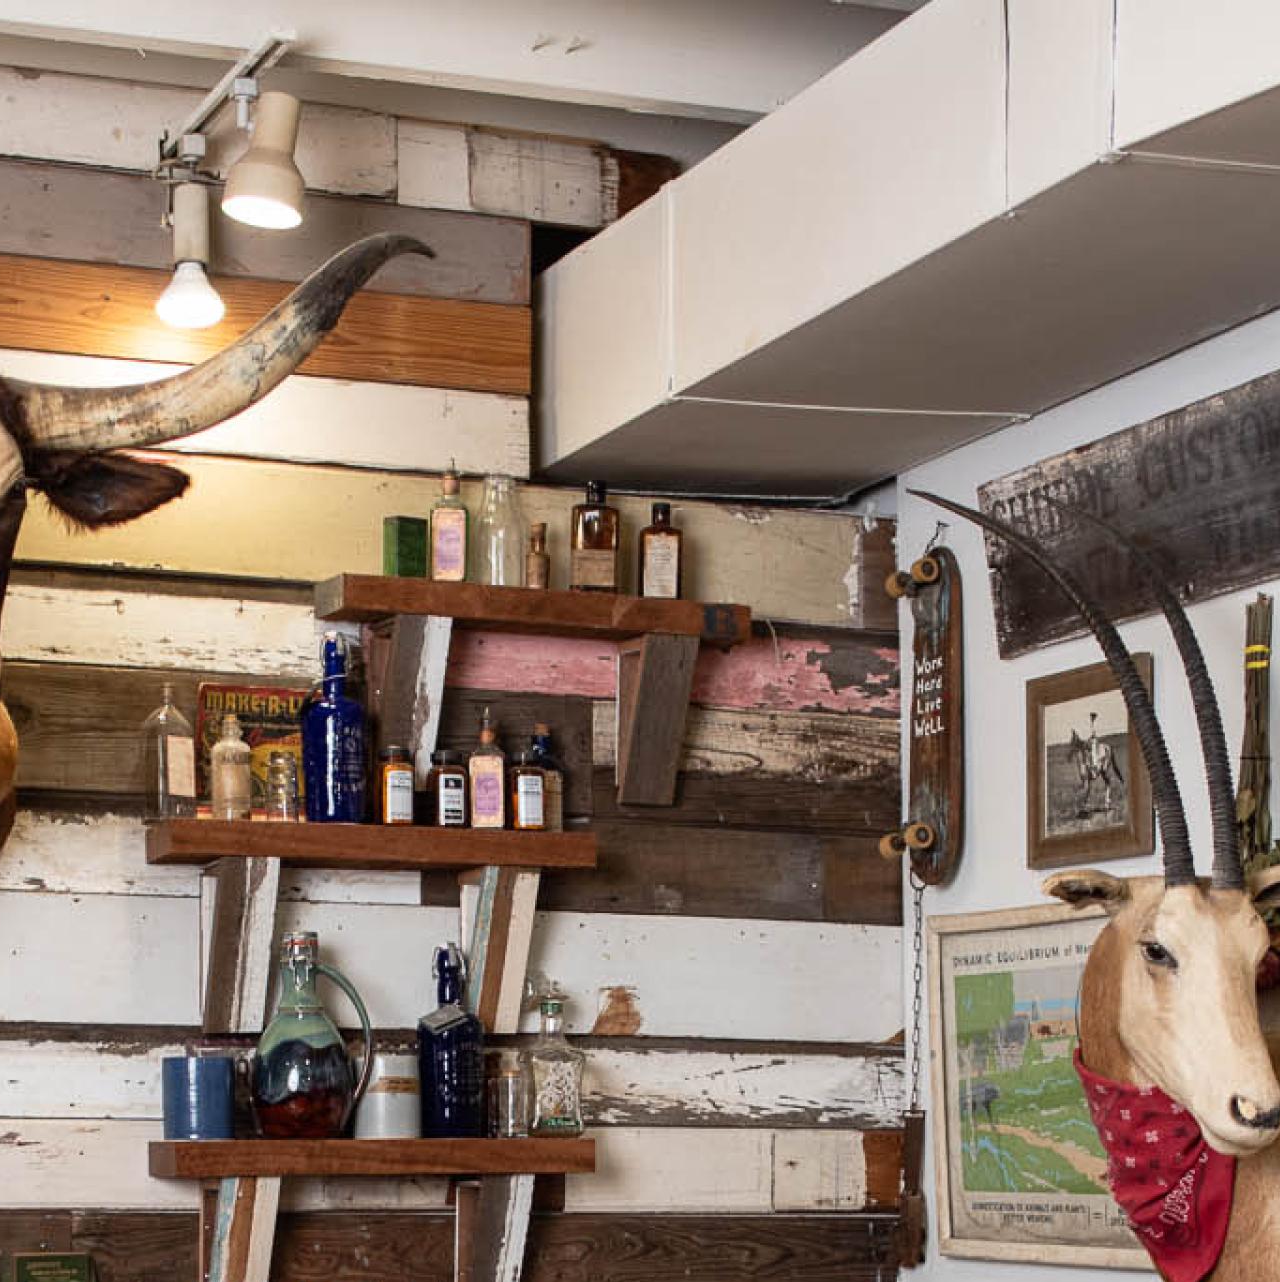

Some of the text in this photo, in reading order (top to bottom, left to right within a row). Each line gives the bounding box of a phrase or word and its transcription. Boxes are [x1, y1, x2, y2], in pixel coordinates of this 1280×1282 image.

[915, 656, 943, 675] Work
[916, 697, 942, 715] Live
[997, 945, 1059, 963] EQUILIBRIUM
